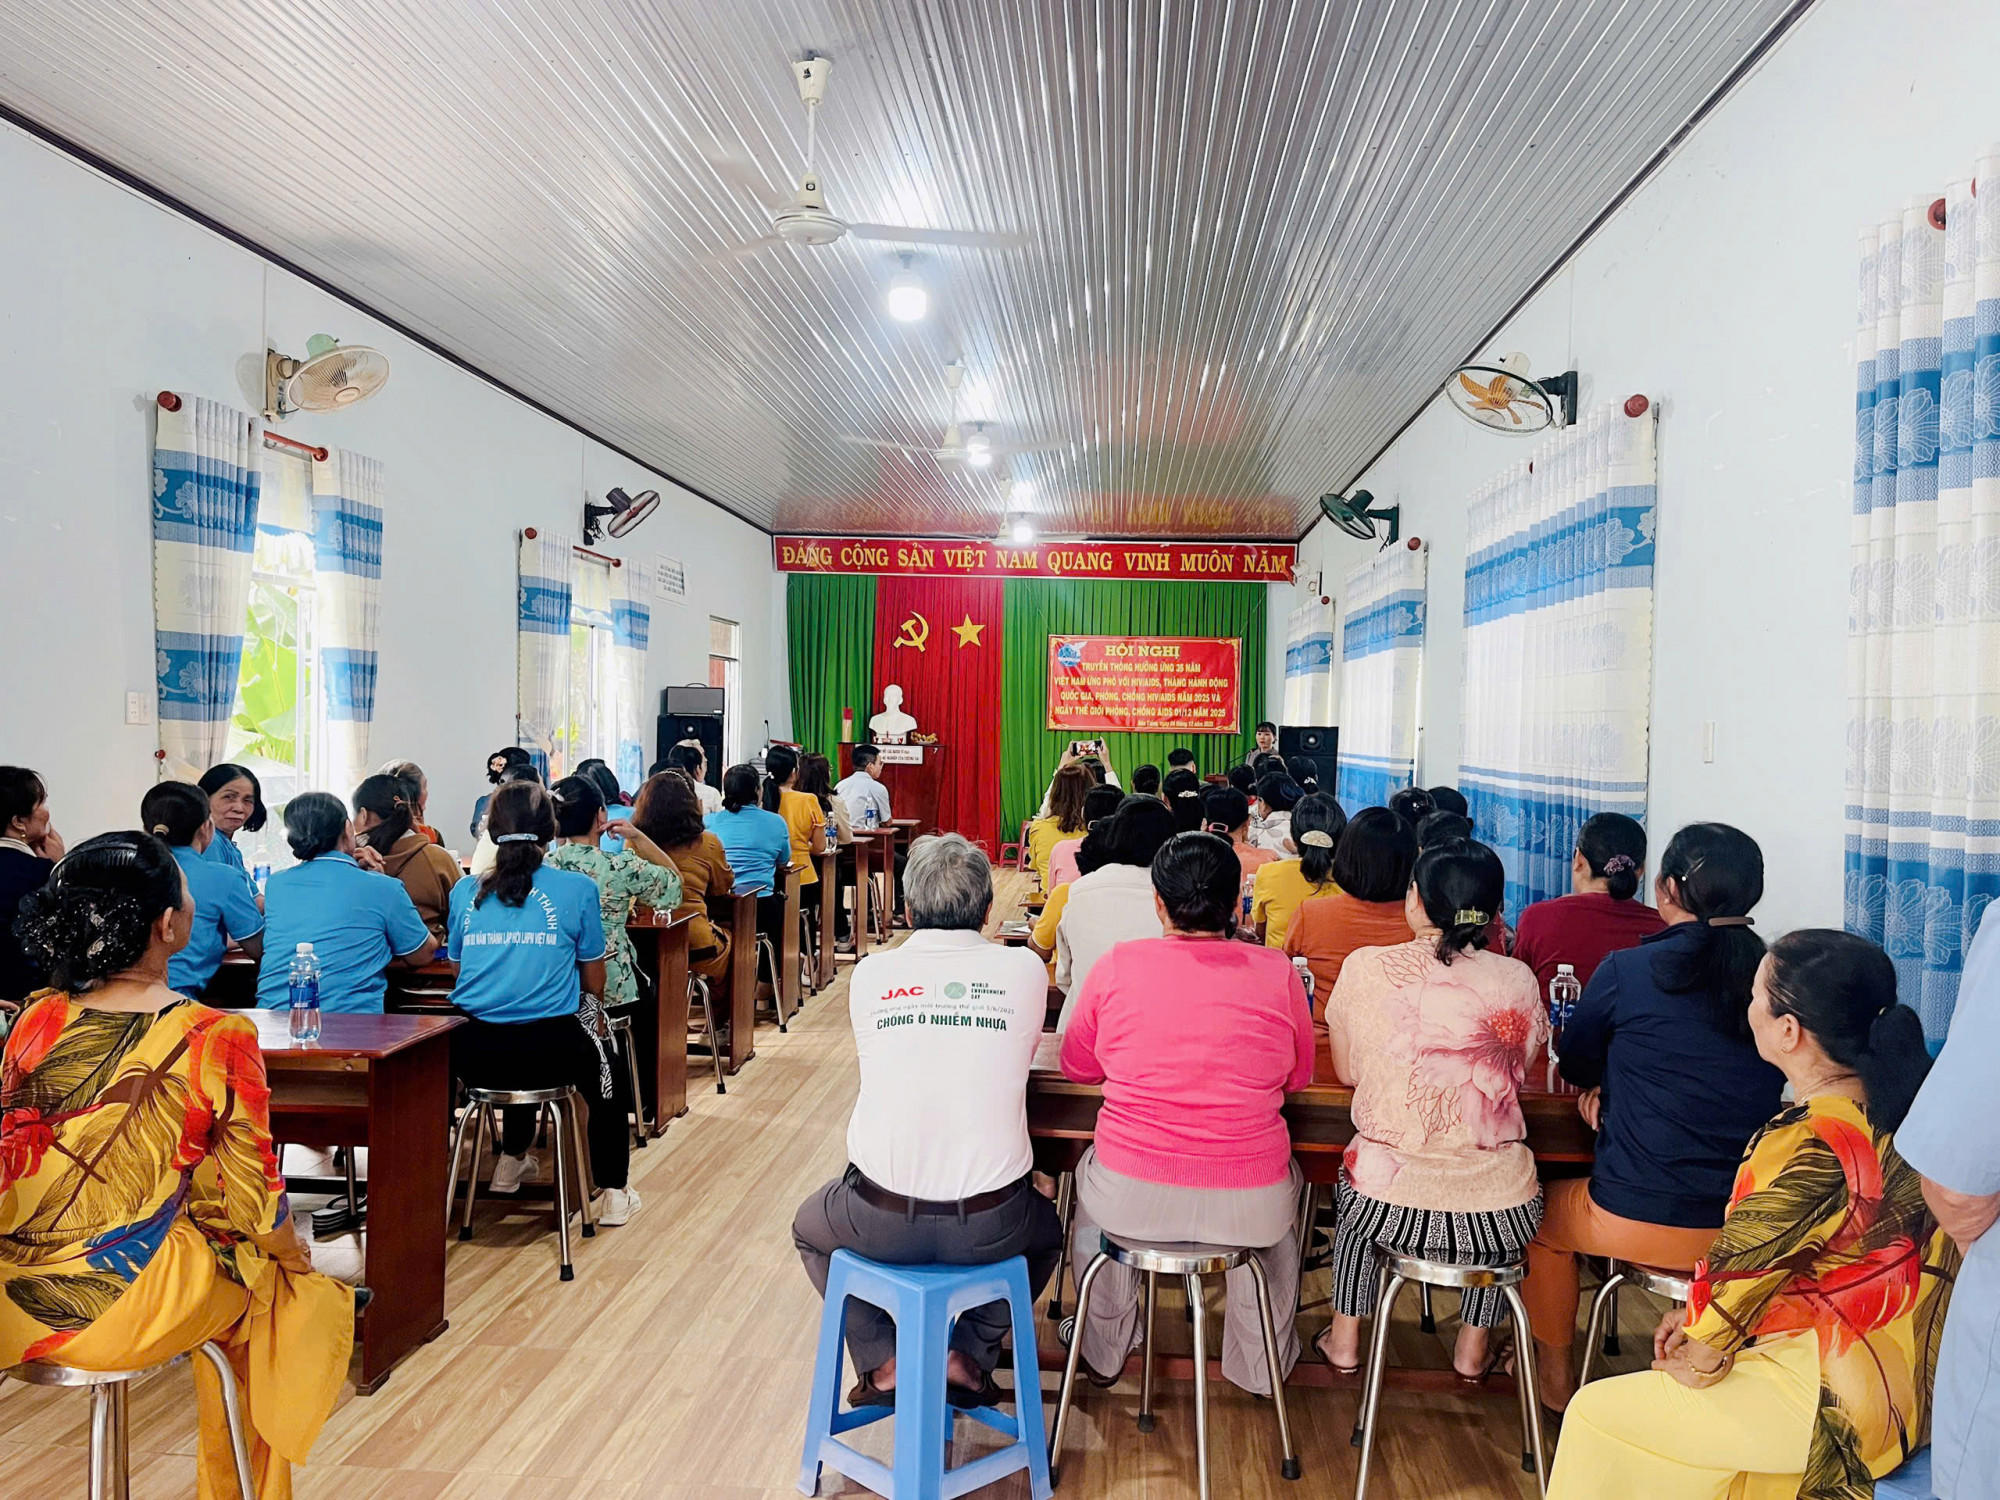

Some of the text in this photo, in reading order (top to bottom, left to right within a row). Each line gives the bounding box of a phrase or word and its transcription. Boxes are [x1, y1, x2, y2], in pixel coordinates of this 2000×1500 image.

[782, 540, 1287, 575] ĐẢNG CỘNG SẢN VIỆT NAM QUANG VINH MUÔN NĂM
[1105, 642, 1180, 659] HỘI NGHỊ
[881, 986, 925, 1000] JAC
[971, 988, 1006, 996] ENVIRONMENT
[877, 1011, 1007, 1032] CHỐNG Ô NHIỄM NHỰA
